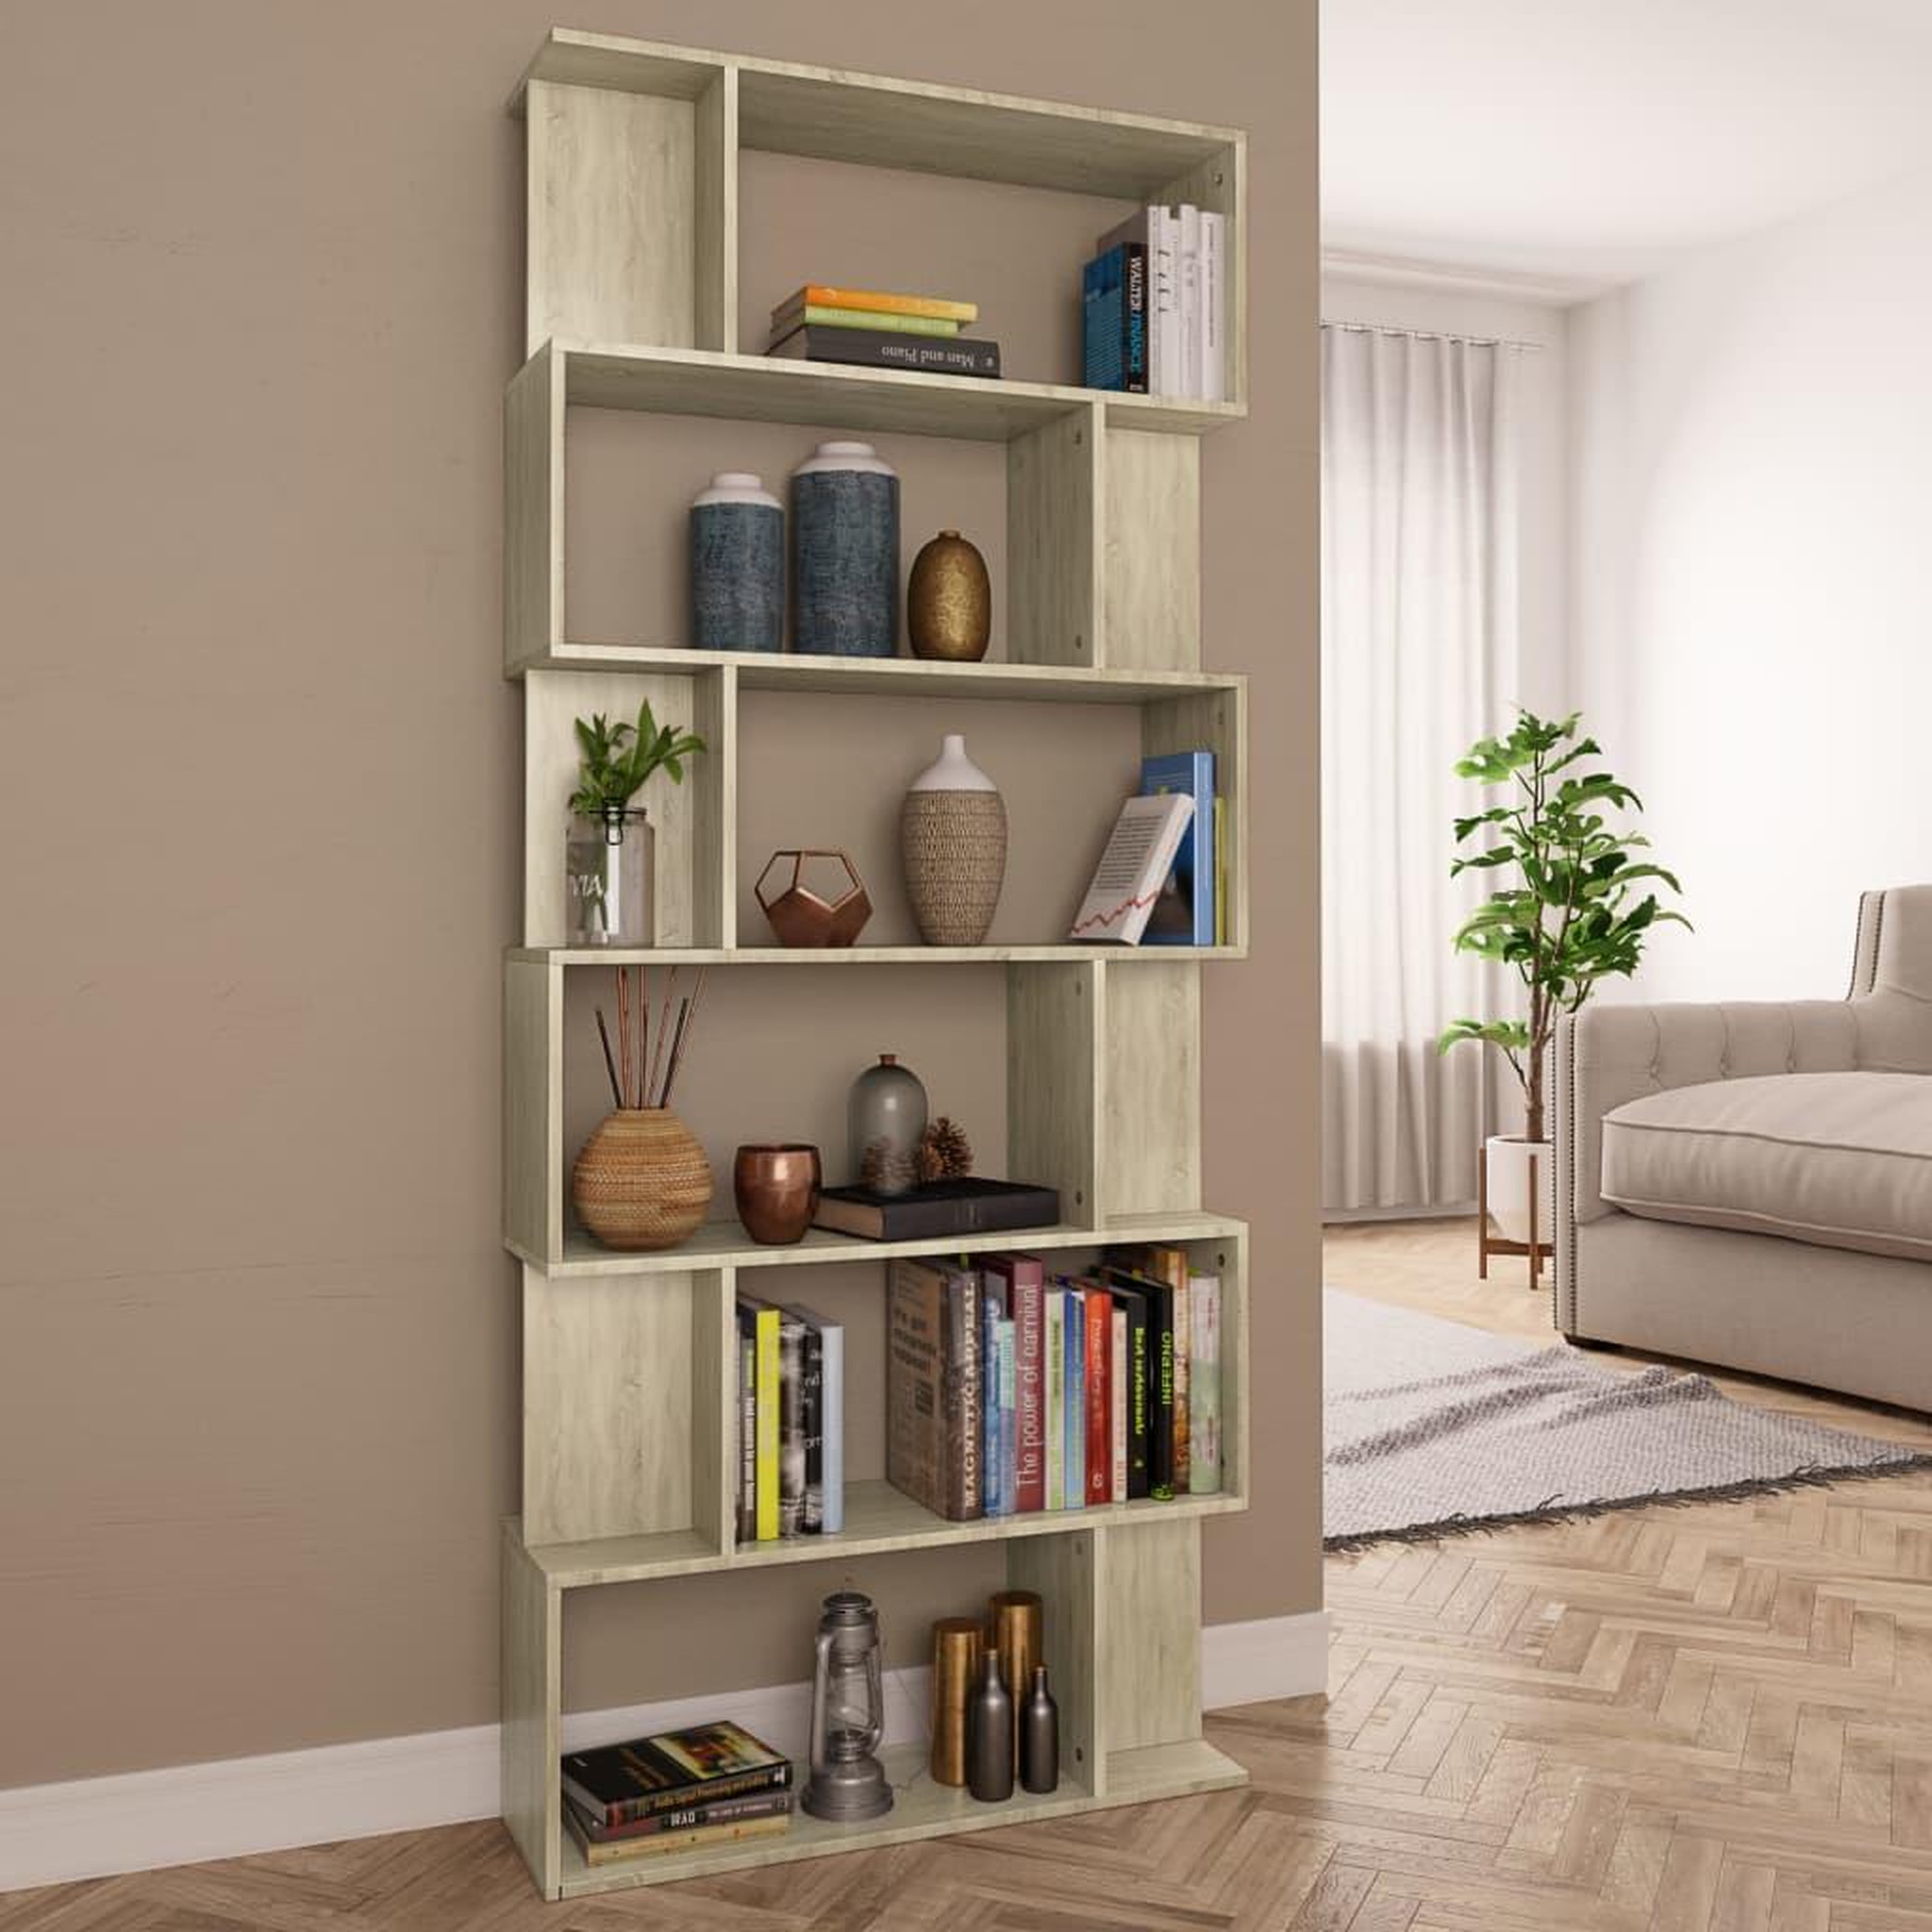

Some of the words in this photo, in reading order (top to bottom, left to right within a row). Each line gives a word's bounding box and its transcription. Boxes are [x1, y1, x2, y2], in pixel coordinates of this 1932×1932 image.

[881, 346, 917, 363] Piano
[920, 349, 943, 363] and
[947, 352, 974, 368] Man
[963, 1282, 975, 1377] APPEAL
[1016, 1284, 1038, 1357] carnival
[1018, 1364, 1038, 1383] of
[1161, 1331, 1172, 1405] INFERNO
[1023, 1391, 1042, 1447] power
[963, 1380, 975, 1508] MAGNETIC
[1016, 1452, 1038, 1489] The
